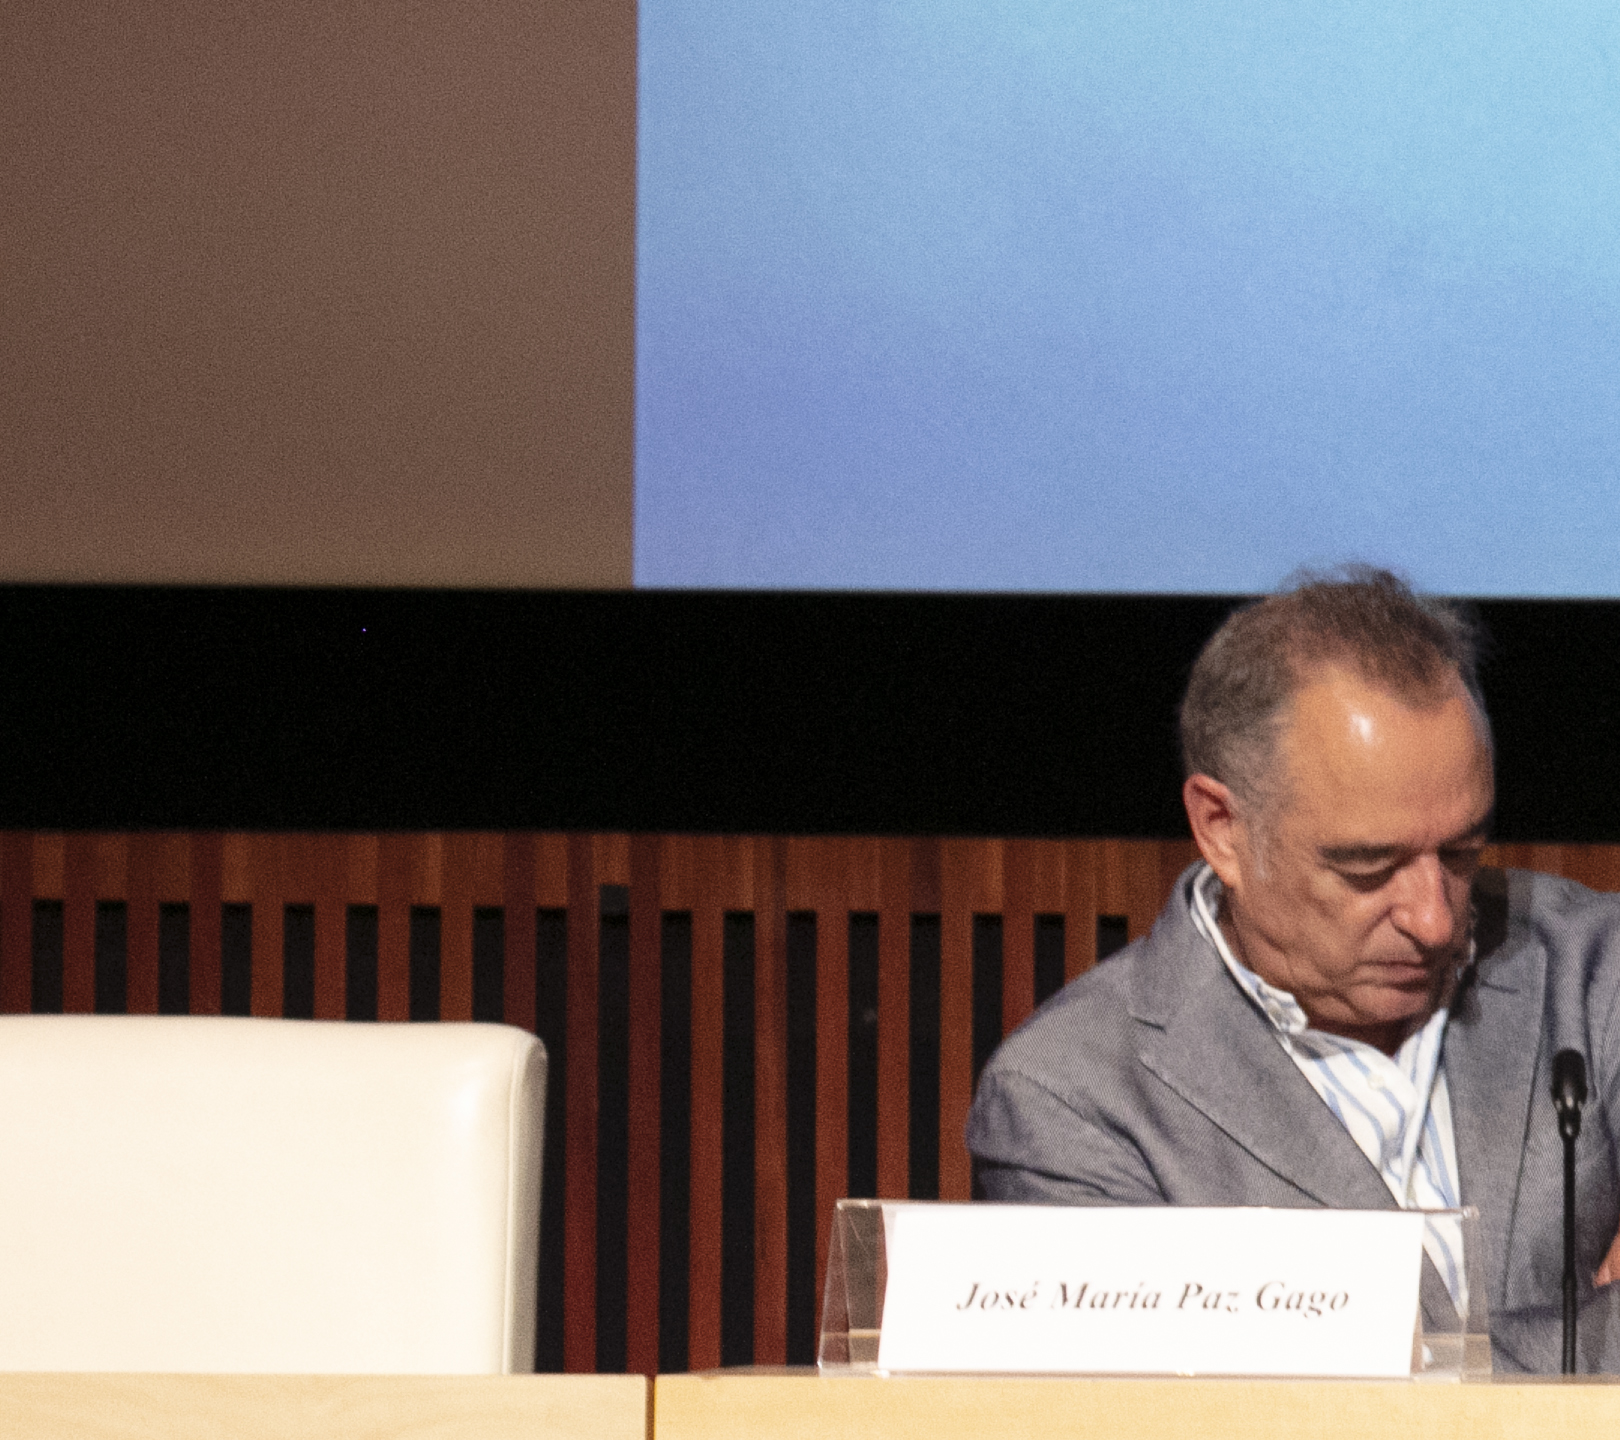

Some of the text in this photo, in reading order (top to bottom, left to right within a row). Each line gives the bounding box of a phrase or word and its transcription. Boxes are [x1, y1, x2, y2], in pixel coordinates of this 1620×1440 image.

[957, 1279, 1351, 1317] José María Paz Gago
